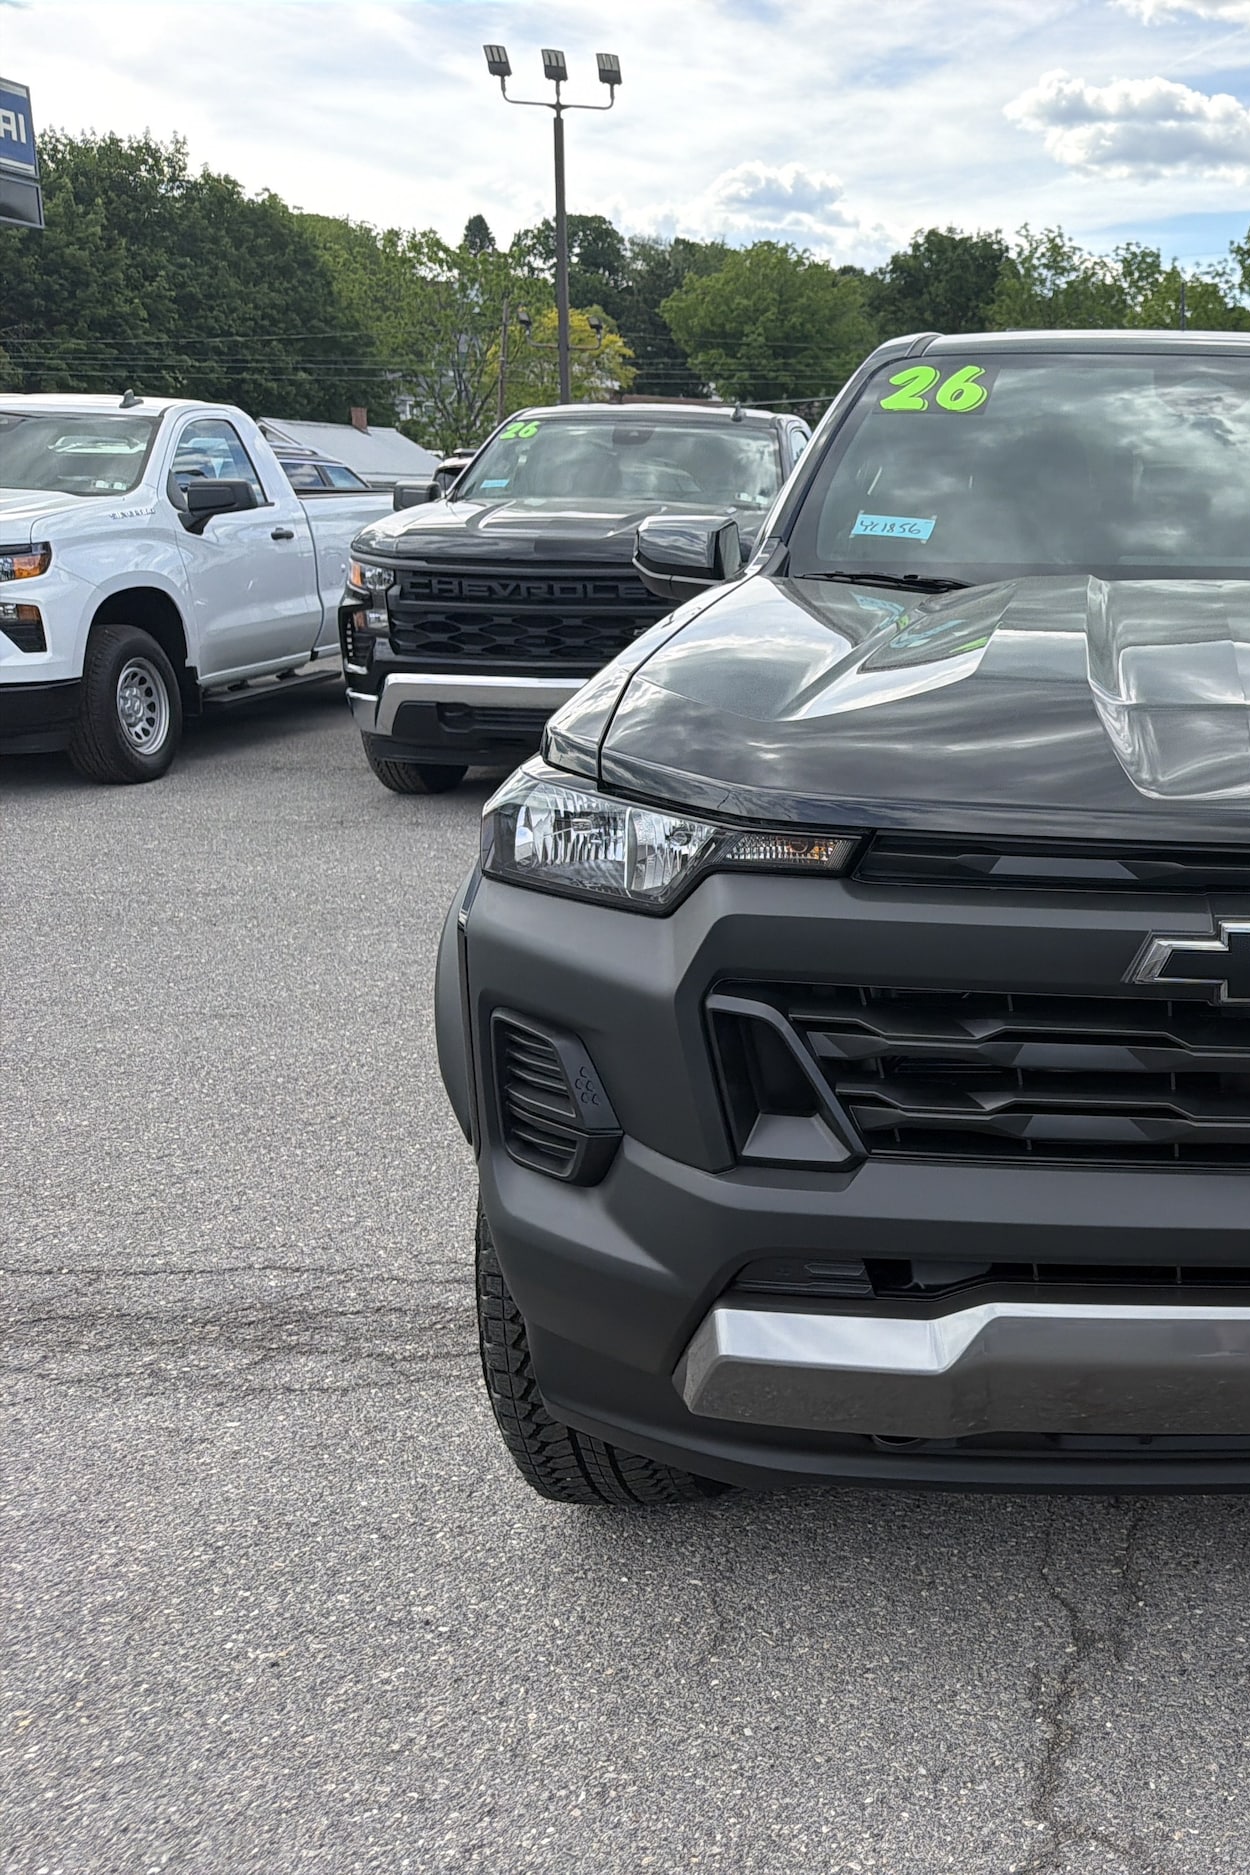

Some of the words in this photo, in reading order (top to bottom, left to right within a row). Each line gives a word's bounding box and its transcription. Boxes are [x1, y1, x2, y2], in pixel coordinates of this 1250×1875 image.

[880, 365, 988, 412] 26
[500, 421, 540, 439] 26
[402, 578, 651, 599] CHEVROLE
